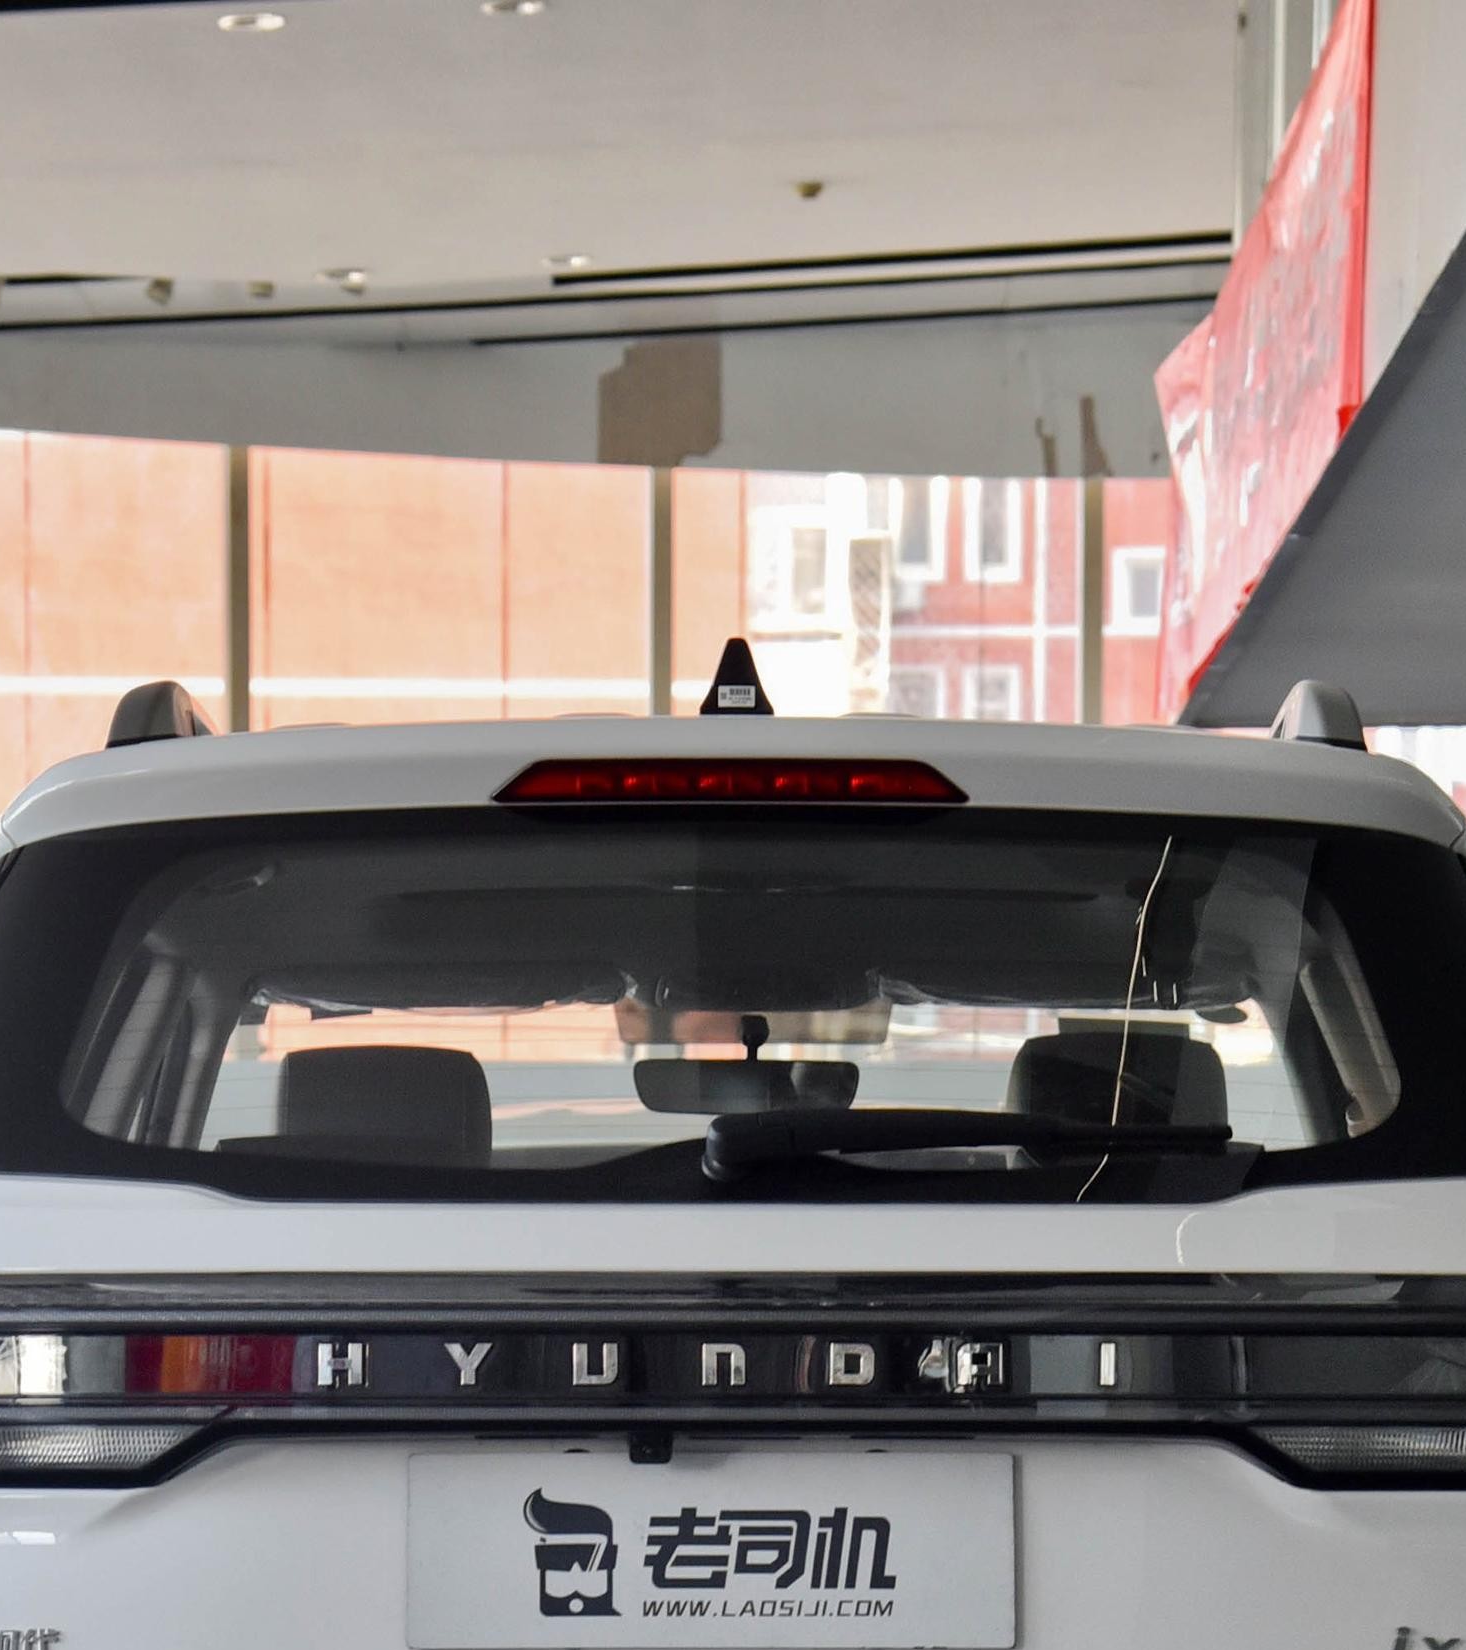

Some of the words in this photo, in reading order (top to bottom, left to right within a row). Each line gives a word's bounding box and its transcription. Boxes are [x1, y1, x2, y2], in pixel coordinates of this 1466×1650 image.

[317, 1342, 1116, 1387] HYUNDAI
[643, 1507, 897, 1589] 老司机
[642, 1599, 894, 1617] WWW.LAOSIJI.COM
